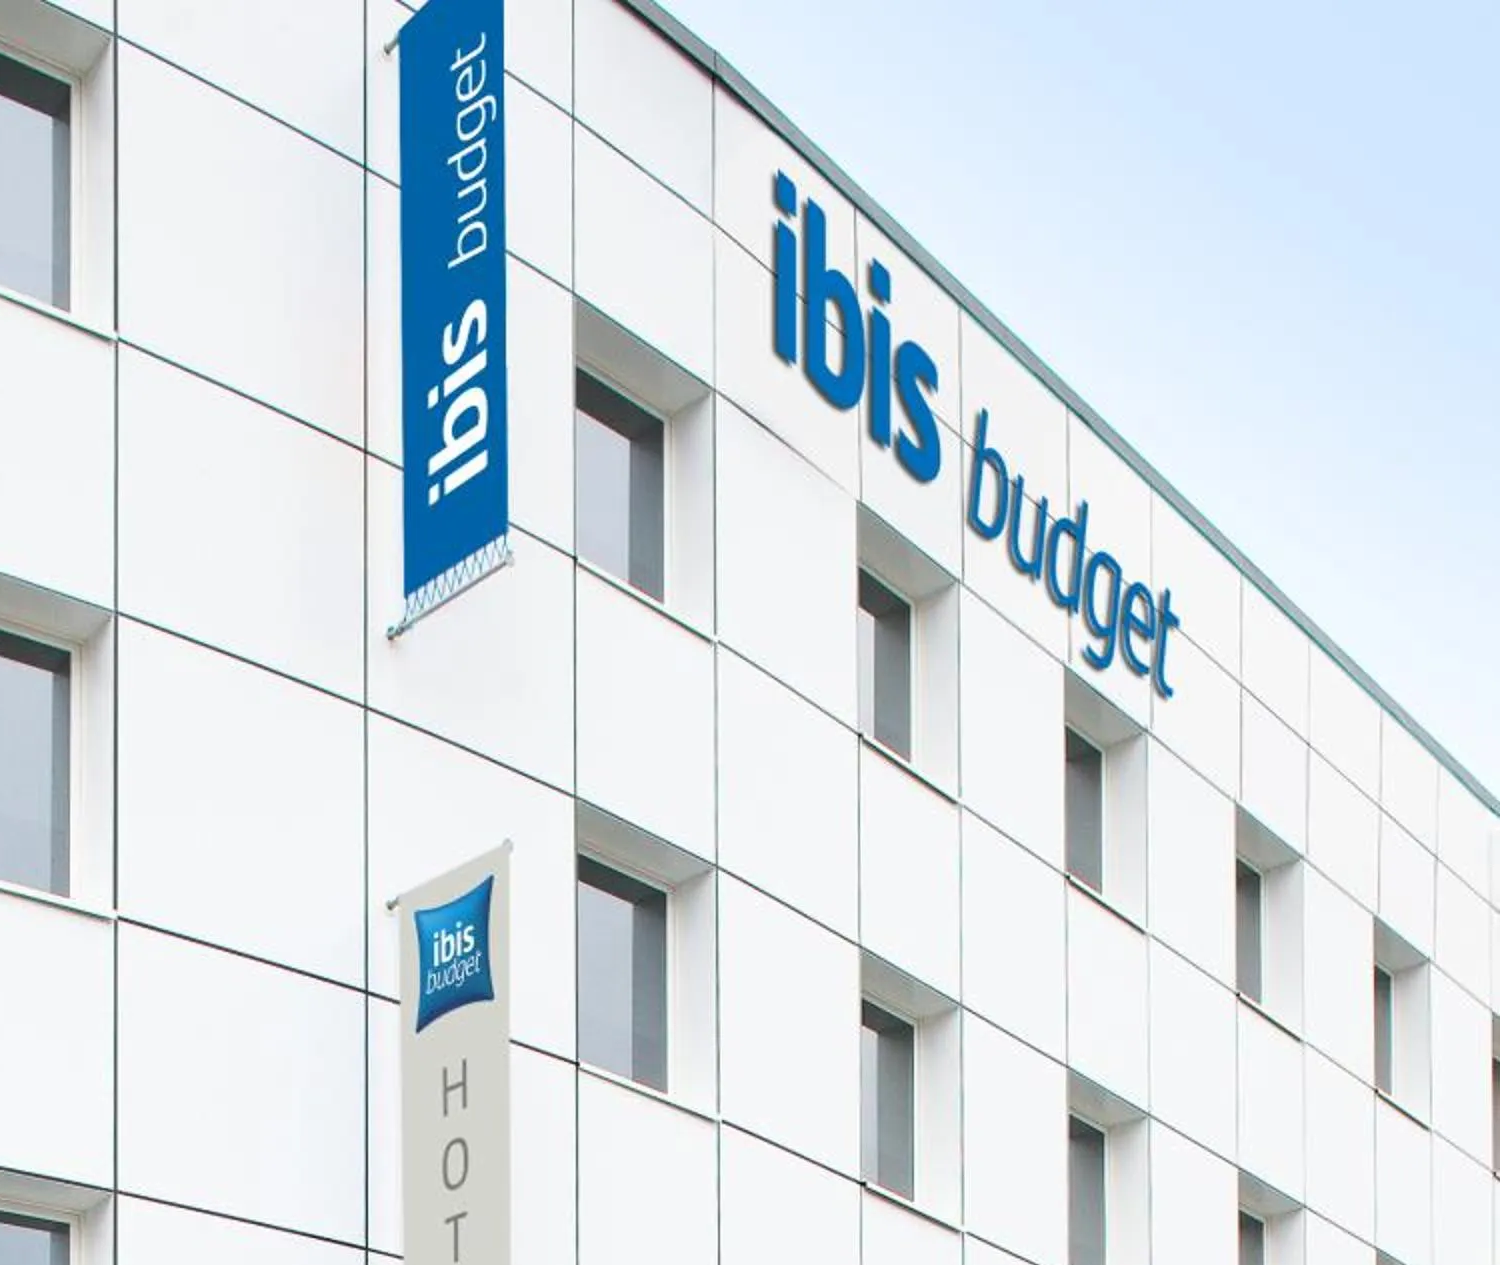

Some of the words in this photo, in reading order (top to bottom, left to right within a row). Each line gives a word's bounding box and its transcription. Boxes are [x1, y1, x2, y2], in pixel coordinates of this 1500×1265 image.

[447, 32, 496, 270] budget
[428, 297, 489, 506] ibis
[772, 168, 941, 484] ibis
[967, 408, 1180, 699] budget
[426, 950, 483, 994] budget
[433, 921, 475, 967] ibis
